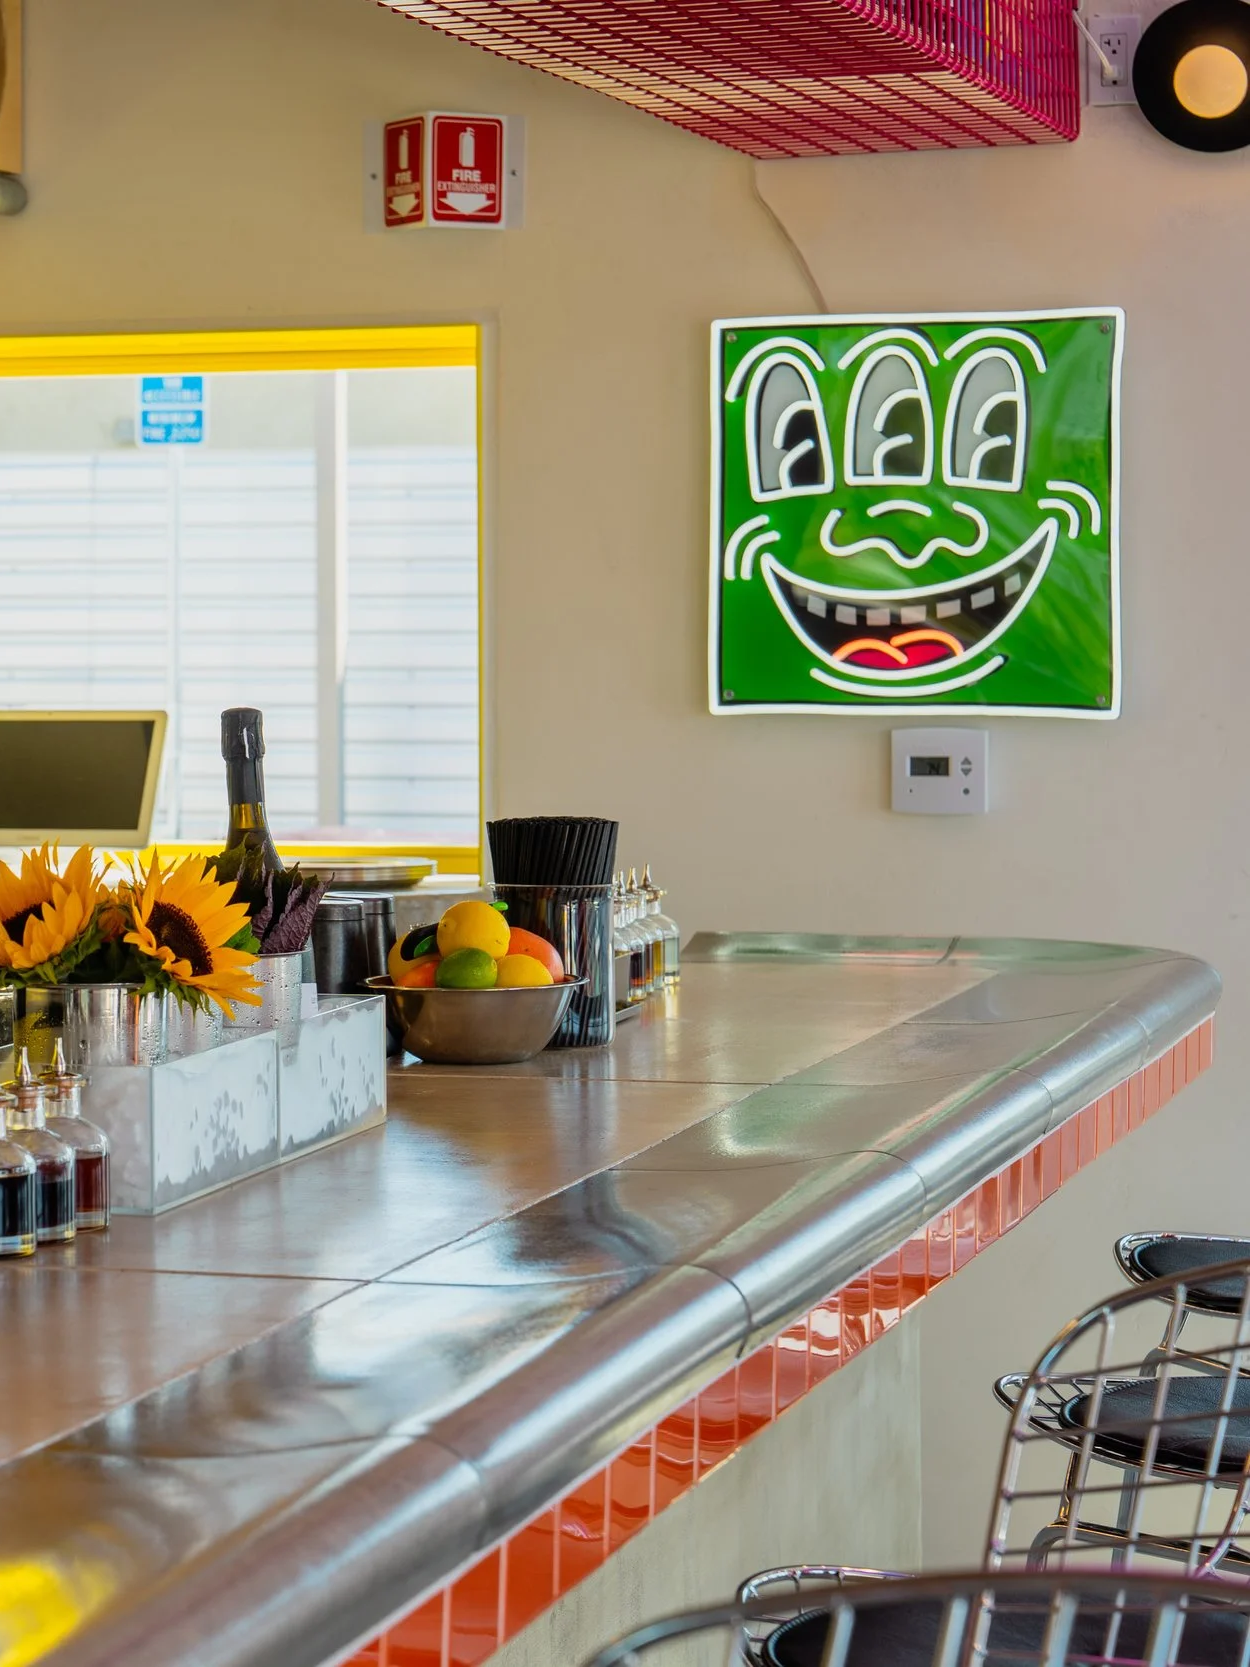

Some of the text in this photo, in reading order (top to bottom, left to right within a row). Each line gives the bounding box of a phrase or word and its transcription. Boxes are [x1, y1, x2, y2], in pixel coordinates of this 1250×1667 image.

[395, 171, 412, 185] FIRE
[452, 169, 481, 182] FIRE
[437, 181, 497, 194] EXTINGUISHER
